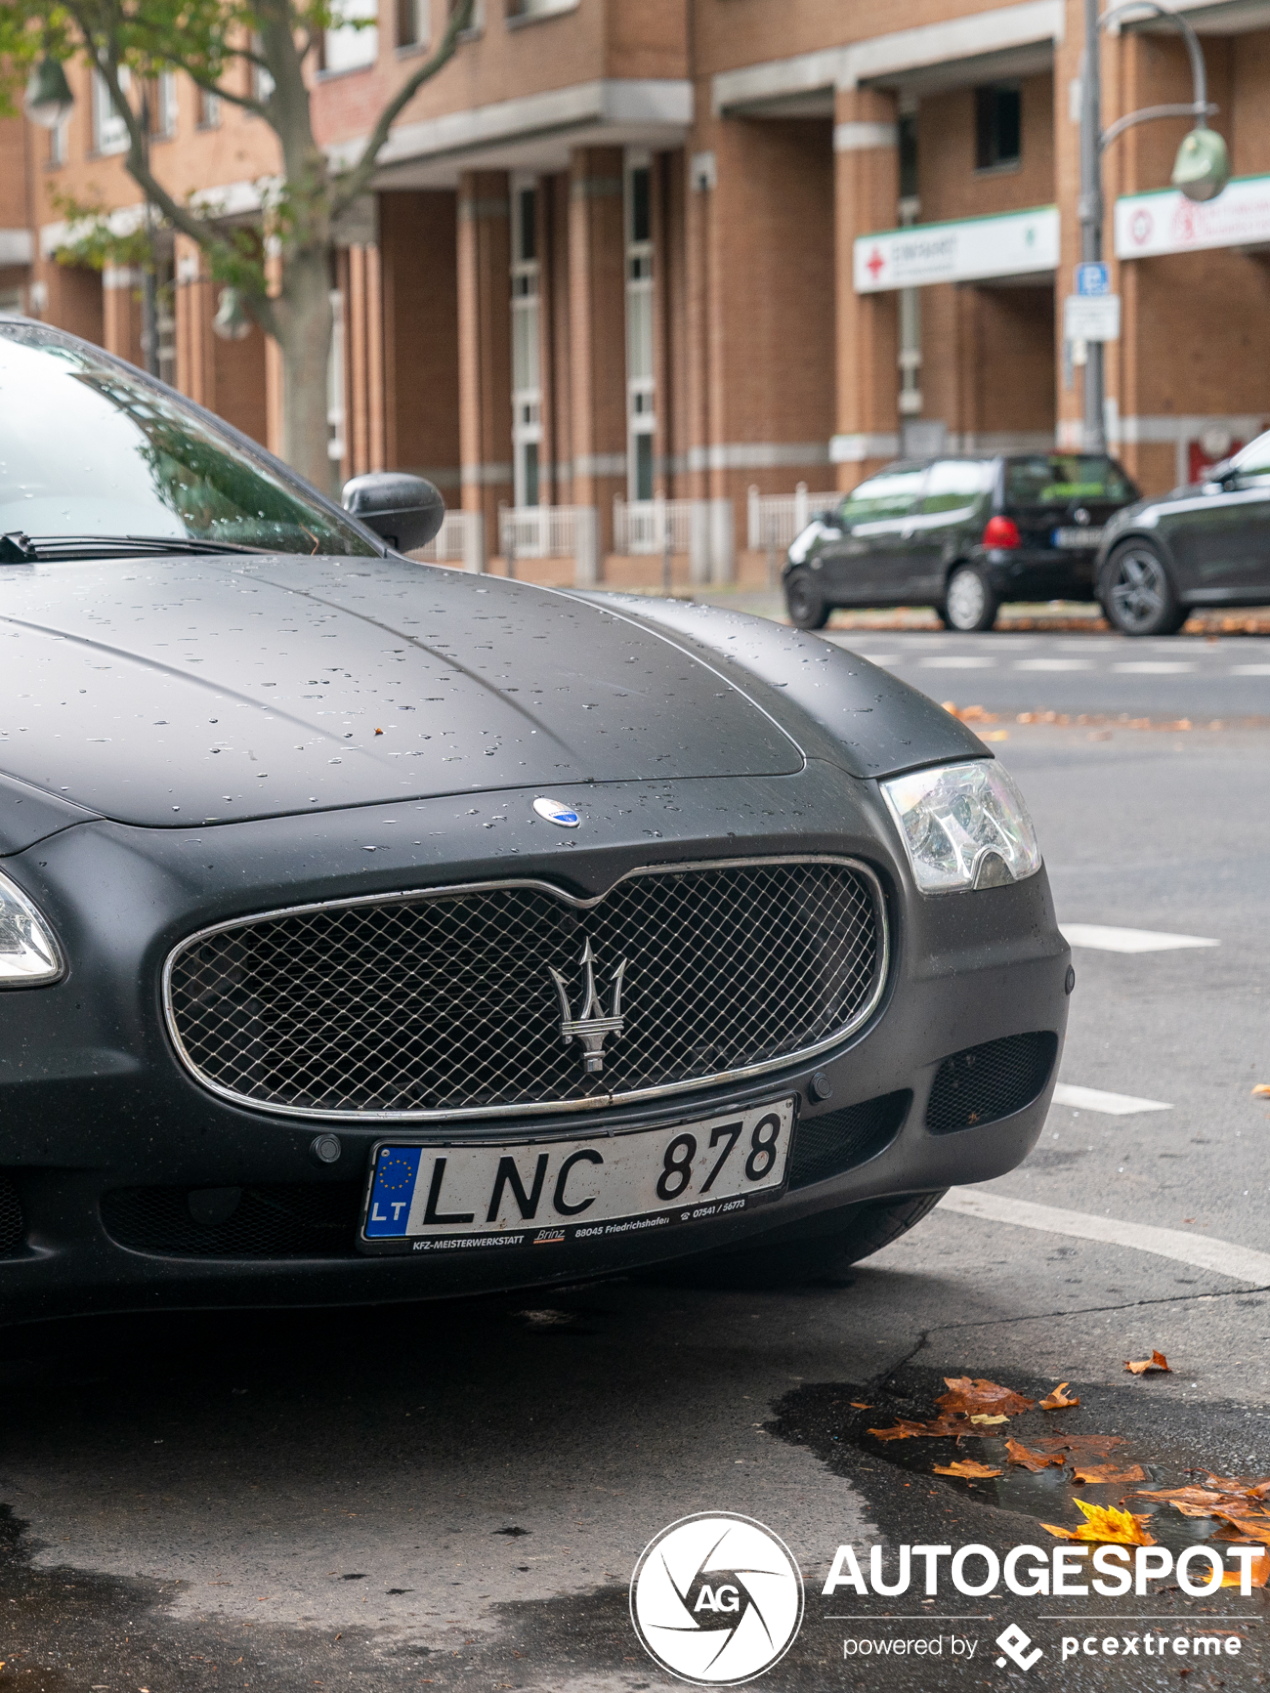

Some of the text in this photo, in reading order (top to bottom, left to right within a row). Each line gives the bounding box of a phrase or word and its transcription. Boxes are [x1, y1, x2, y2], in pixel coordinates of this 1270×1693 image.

[422, 1112, 781, 1225] LNC 878
[371, 1202, 407, 1221] LT
[412, 1235, 525, 1250] KFZ-MEISTERWERKSTATT
[536, 1229, 566, 1241] Brinz
[575, 1226, 603, 1238] 88045
[604, 1217, 670, 1234] Friedrichshafen
[692, 1206, 716, 1218] 07541
